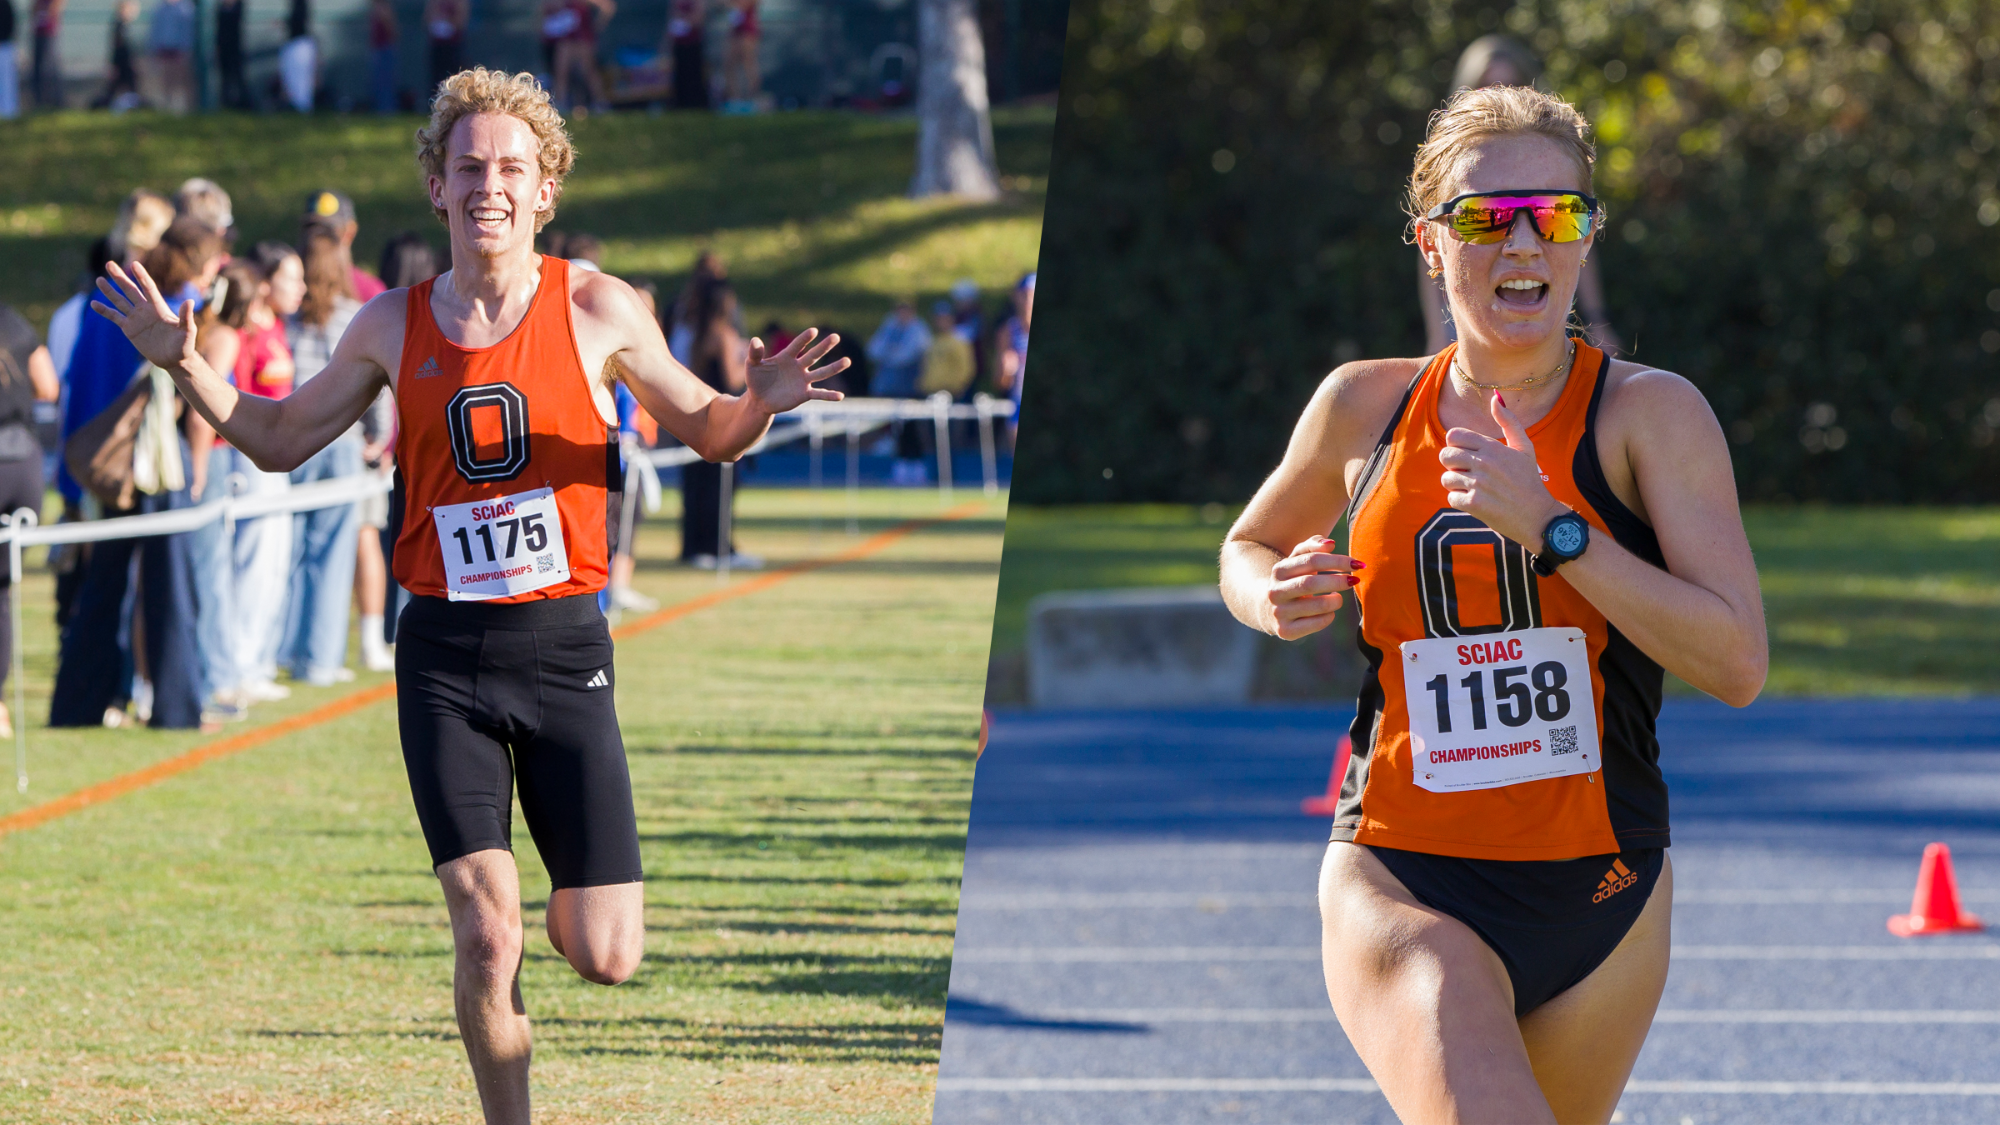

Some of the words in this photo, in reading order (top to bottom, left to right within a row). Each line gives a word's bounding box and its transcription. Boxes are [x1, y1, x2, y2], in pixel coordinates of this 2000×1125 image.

[414, 368, 444, 380] adidas
[472, 501, 515, 521] SCIAC
[453, 512, 548, 564] 1175
[1558, 527, 1579, 545] 21:46
[460, 565, 533, 585] CHAMPIONSHIPS
[1458, 639, 1523, 666] SCIAC
[1426, 660, 1571, 733] 1158
[1430, 739, 1542, 764] CHAMPIONSHIPS
[1592, 872, 1638, 903] adidas
